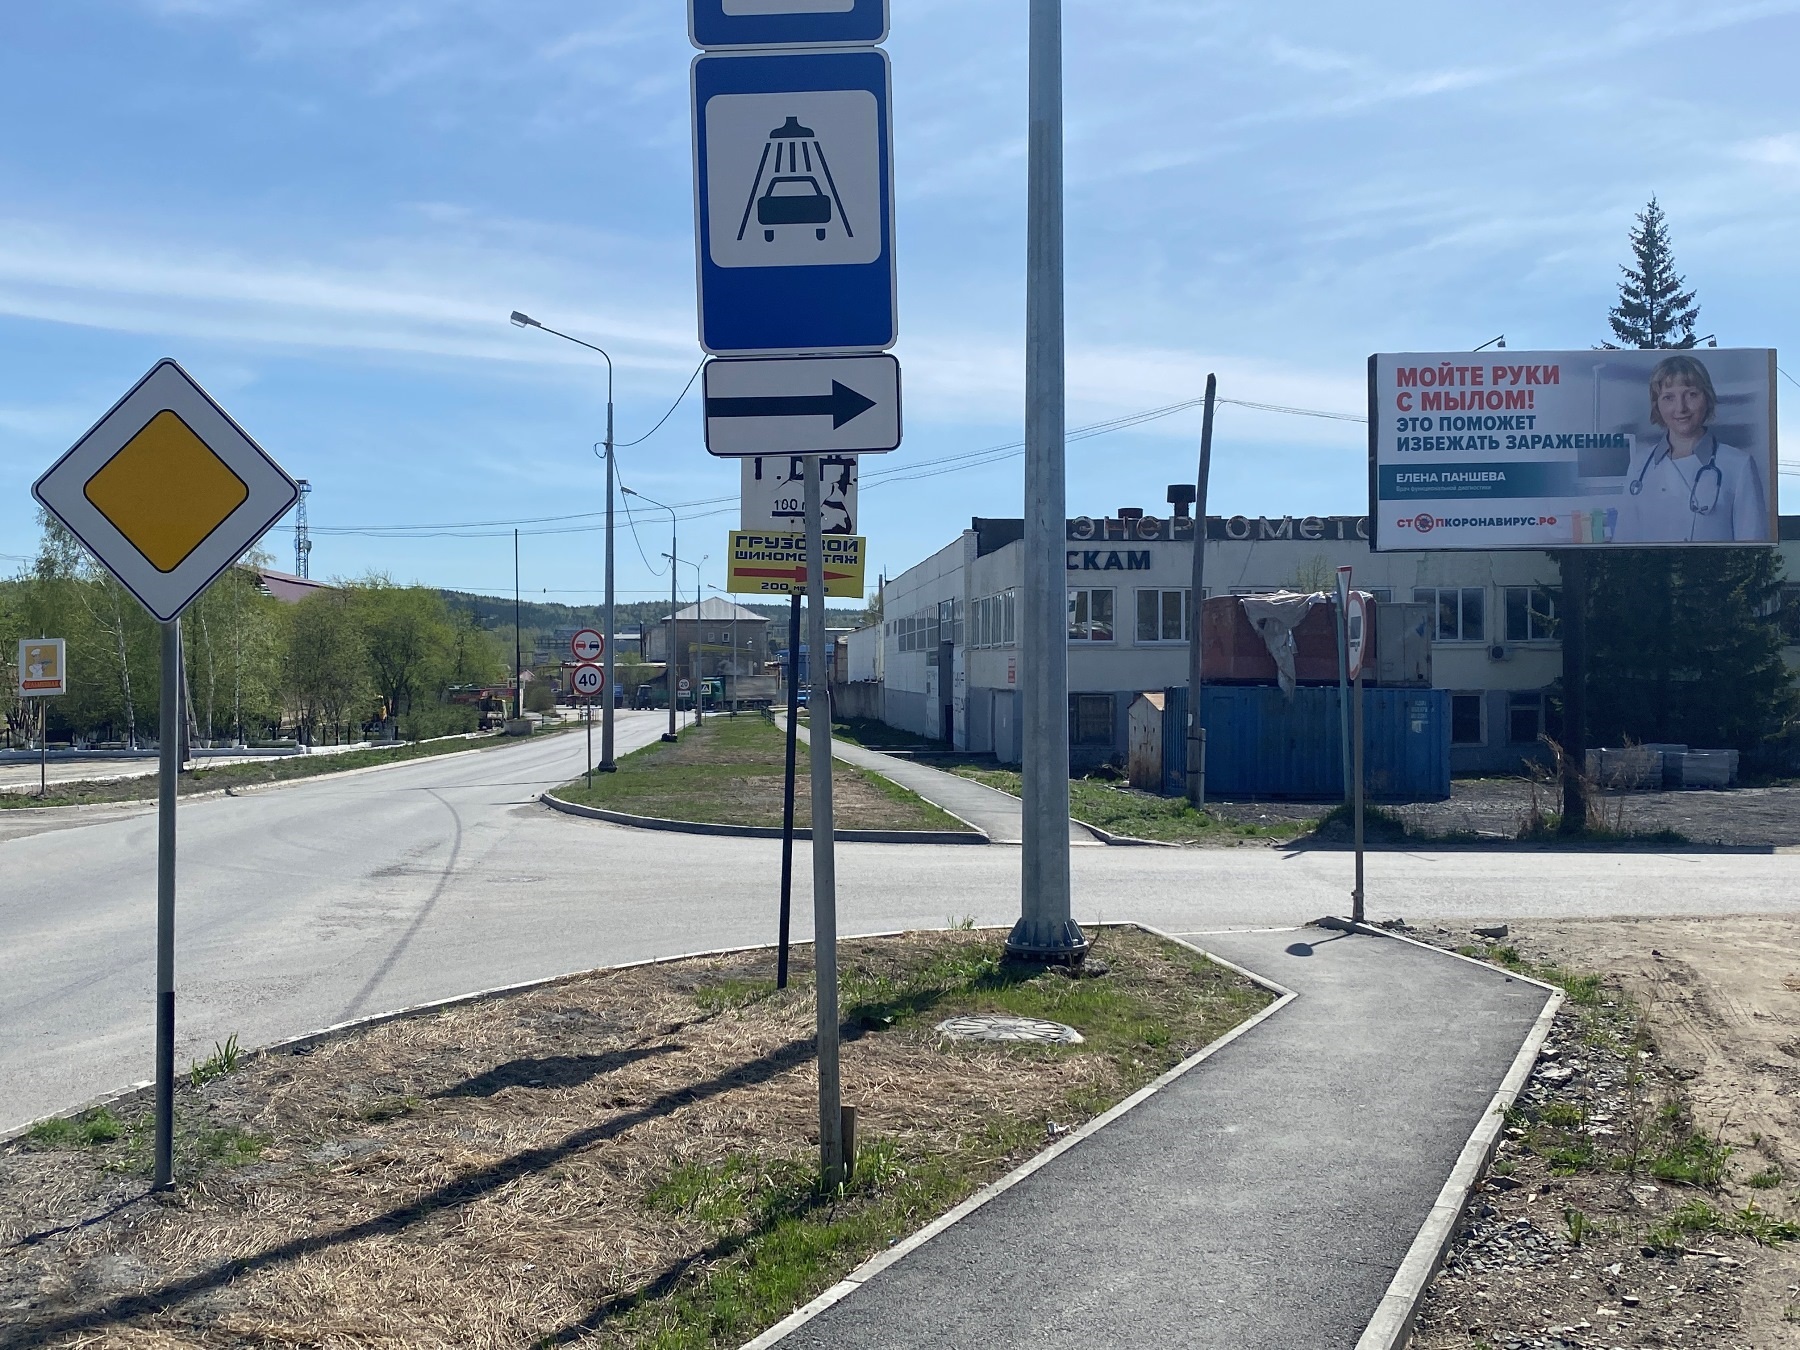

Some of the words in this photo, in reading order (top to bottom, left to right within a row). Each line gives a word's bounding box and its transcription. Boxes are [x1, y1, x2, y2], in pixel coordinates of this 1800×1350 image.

[1397, 362, 1484, 388] МОЙТЕ
[1493, 365, 1560, 386] РУКИ
[1396, 392, 1413, 412] С
[1421, 390, 1535, 412] МЫЛОМ!
[1396, 417, 1433, 433] ЭТО
[1440, 415, 1536, 432] ПОМОЖЕТ
[1397, 436, 1500, 452] ИЗБЕЖАТЬ
[1396, 473, 1439, 483] ЕЛЕНА
[1442, 471, 1506, 482] ПАНШЕВА
[774, 499, 798, 511] 100
[736, 535, 859, 552] ГРУЗООЙ
[735, 551, 858, 564] ШИНОМОТАЖ
[761, 582, 789, 590] 200
[794, 585, 829, 593] мев
[578, 673, 597, 687] 40
